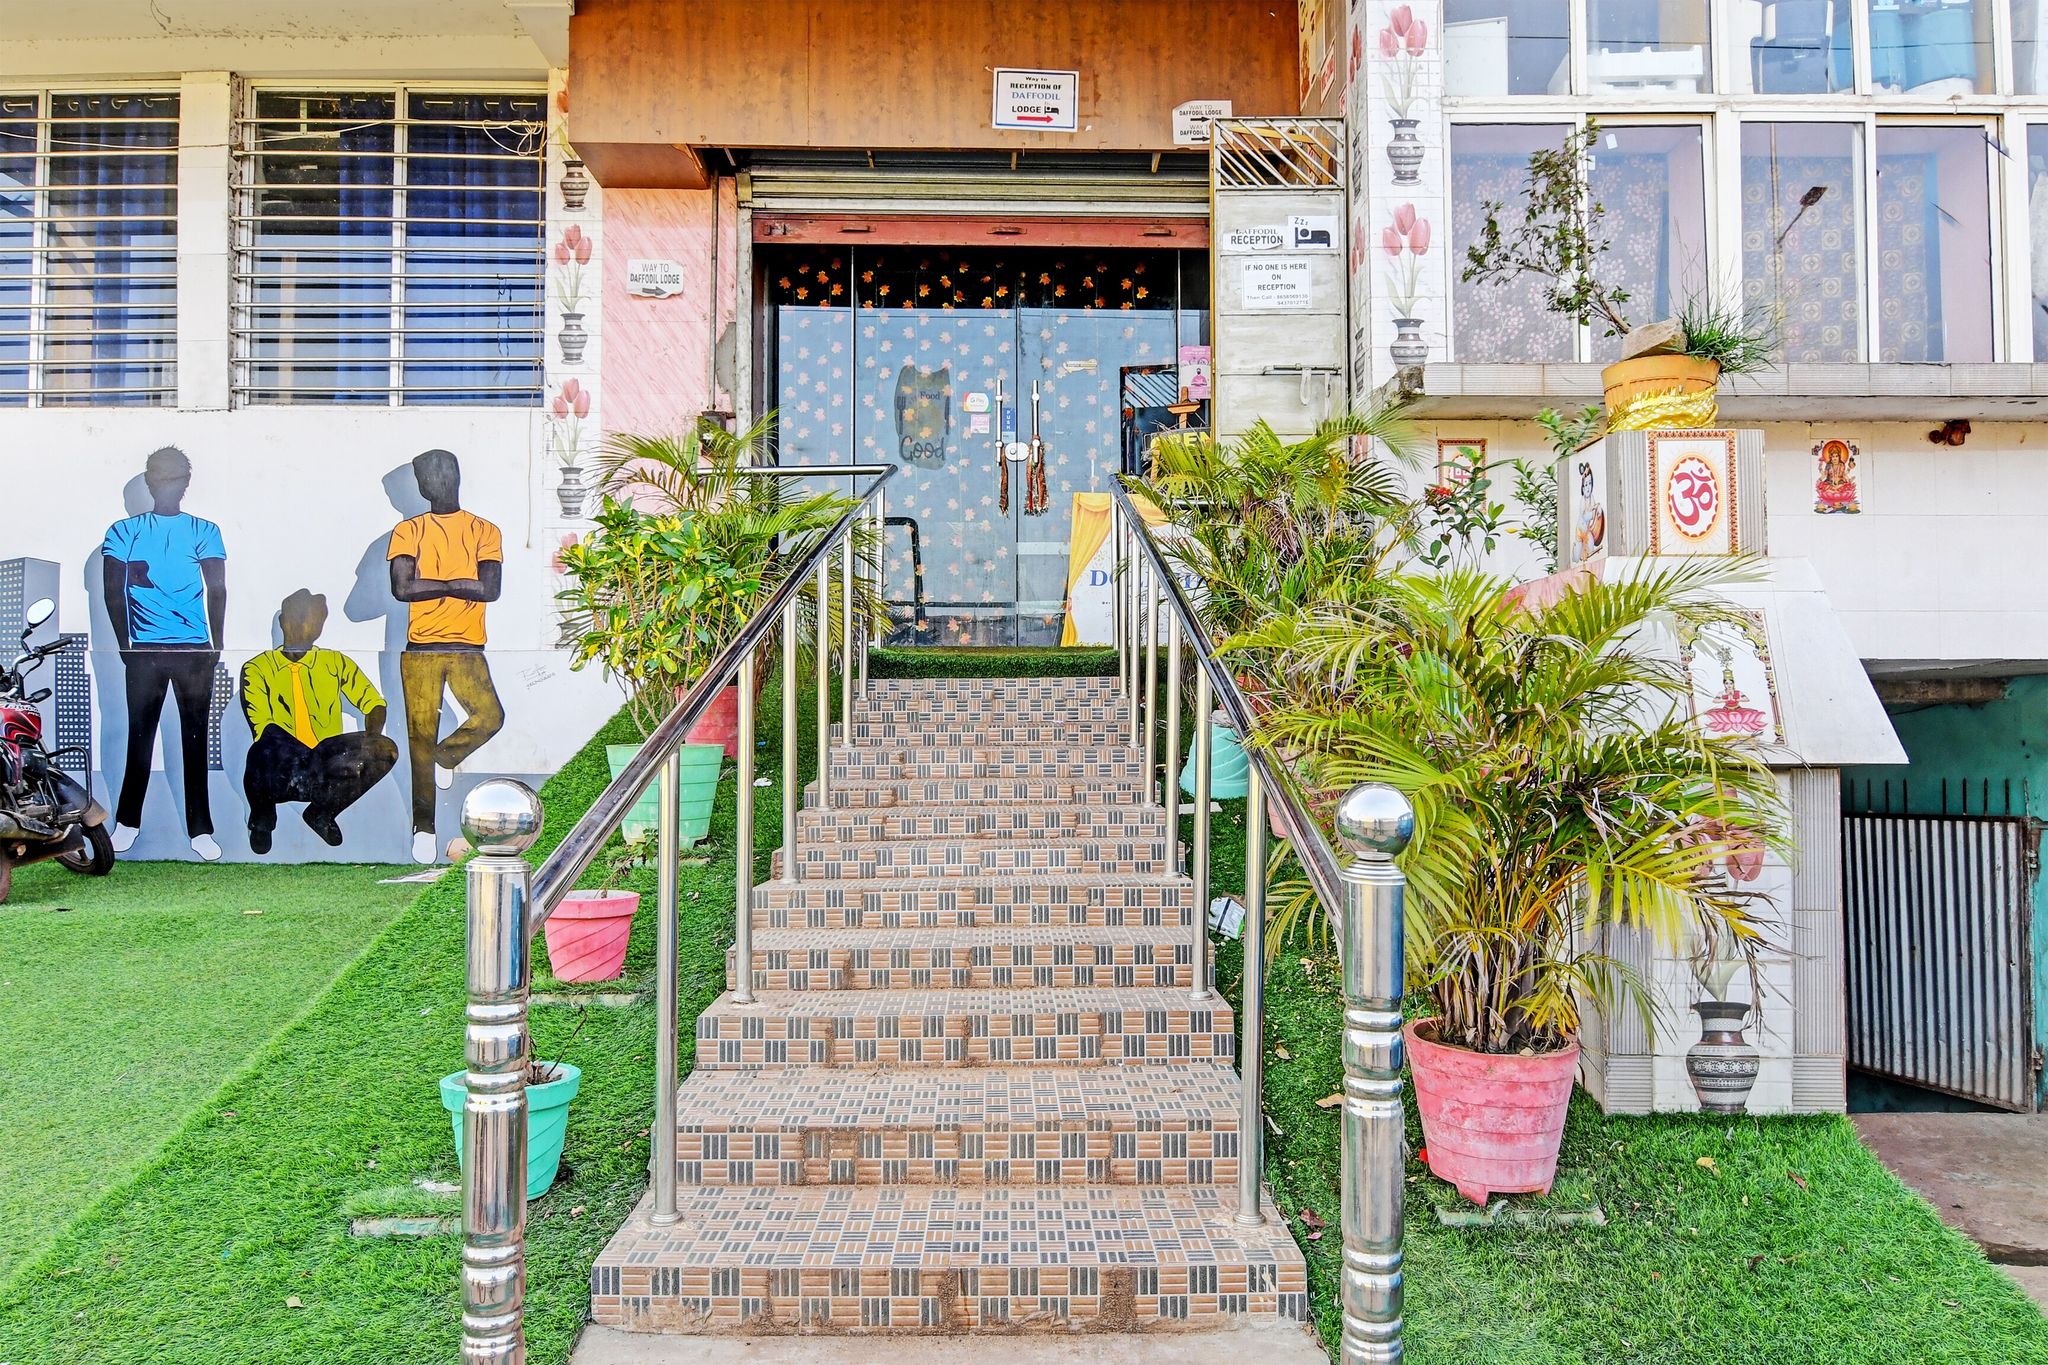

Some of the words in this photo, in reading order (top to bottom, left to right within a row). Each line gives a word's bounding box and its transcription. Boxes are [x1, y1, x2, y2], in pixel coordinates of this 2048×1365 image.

[1012, 92, 1061, 100] DAFFODIL
[1230, 235, 1284, 245] RECEPTION
[642, 264, 657, 272] WAY
[660, 264, 669, 273] TO
[1264, 263, 1279, 271] ONE
[630, 273, 659, 284] DAFFODIL
[661, 274, 680, 284] LODGE
[1271, 273, 1282, 281] ON
[1257, 283, 1296, 291] RECEPTION
[919, 391, 941, 400] Food
[900, 435, 945, 462] Good
